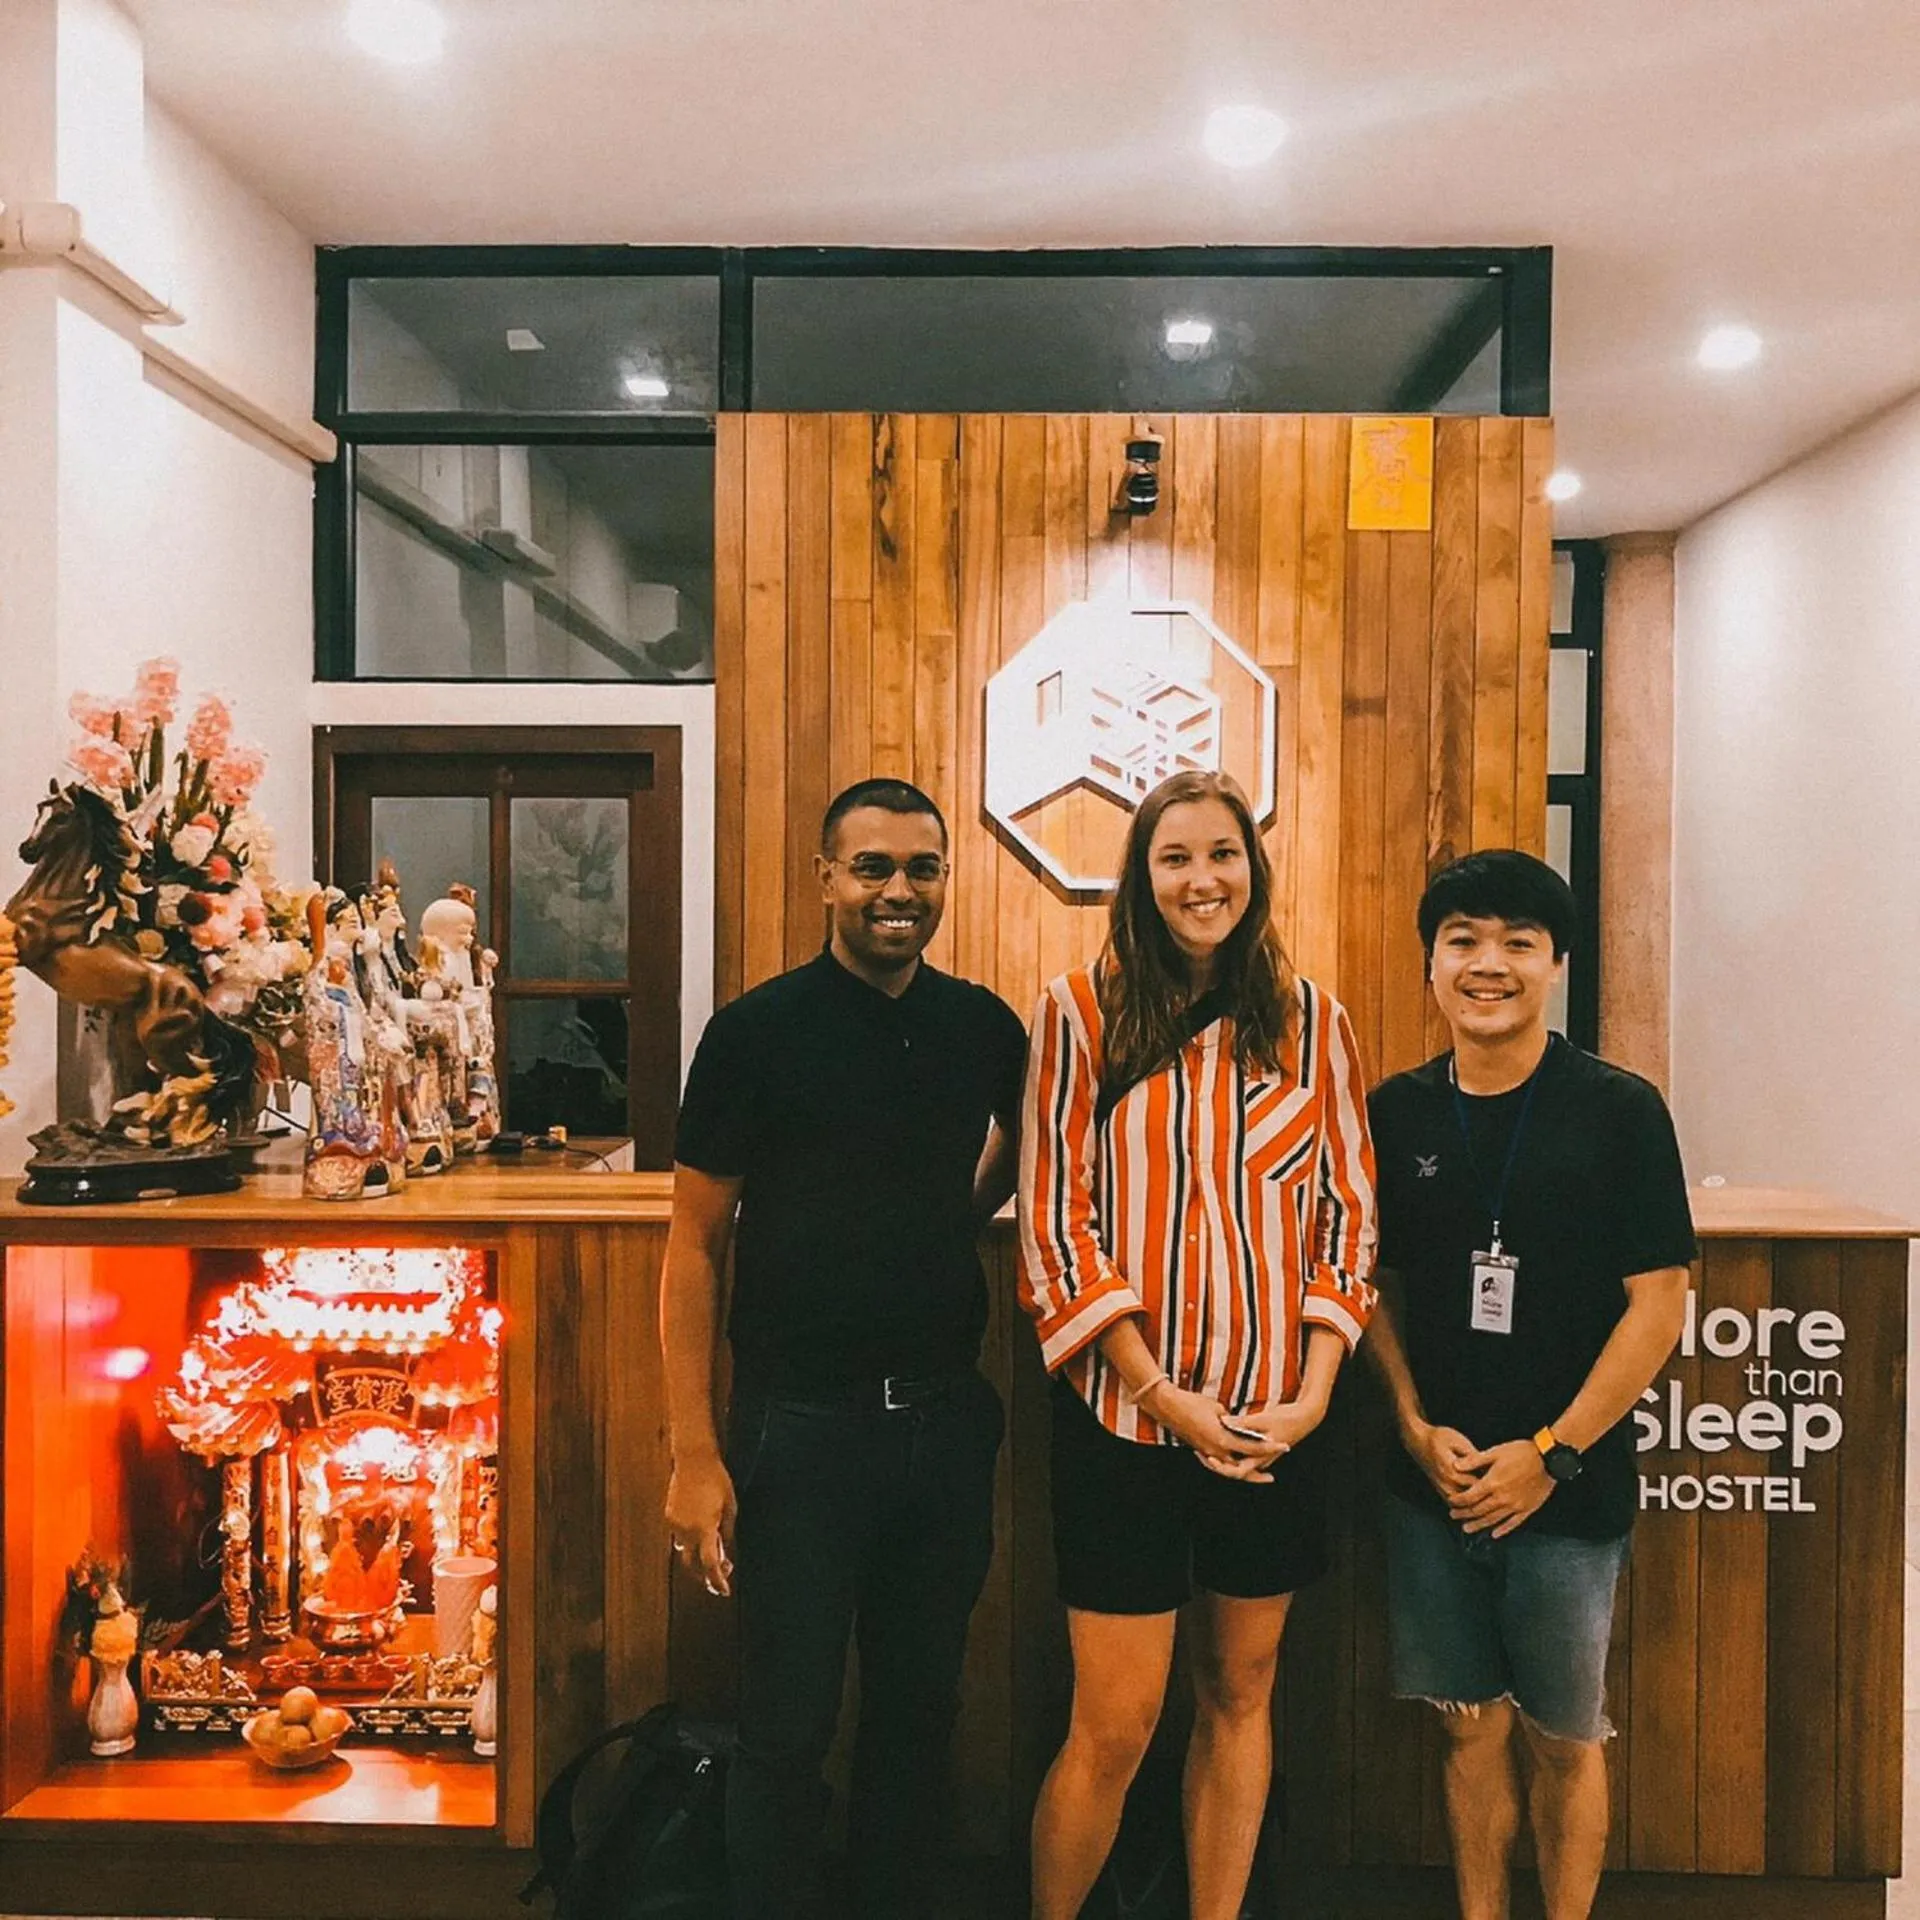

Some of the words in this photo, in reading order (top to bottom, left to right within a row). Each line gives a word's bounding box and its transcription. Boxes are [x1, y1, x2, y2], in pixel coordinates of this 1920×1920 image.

[1681, 1289, 1845, 1359] ore
[1744, 1360, 1843, 1397] than
[1638, 1475, 1816, 1511] HOSTEL
